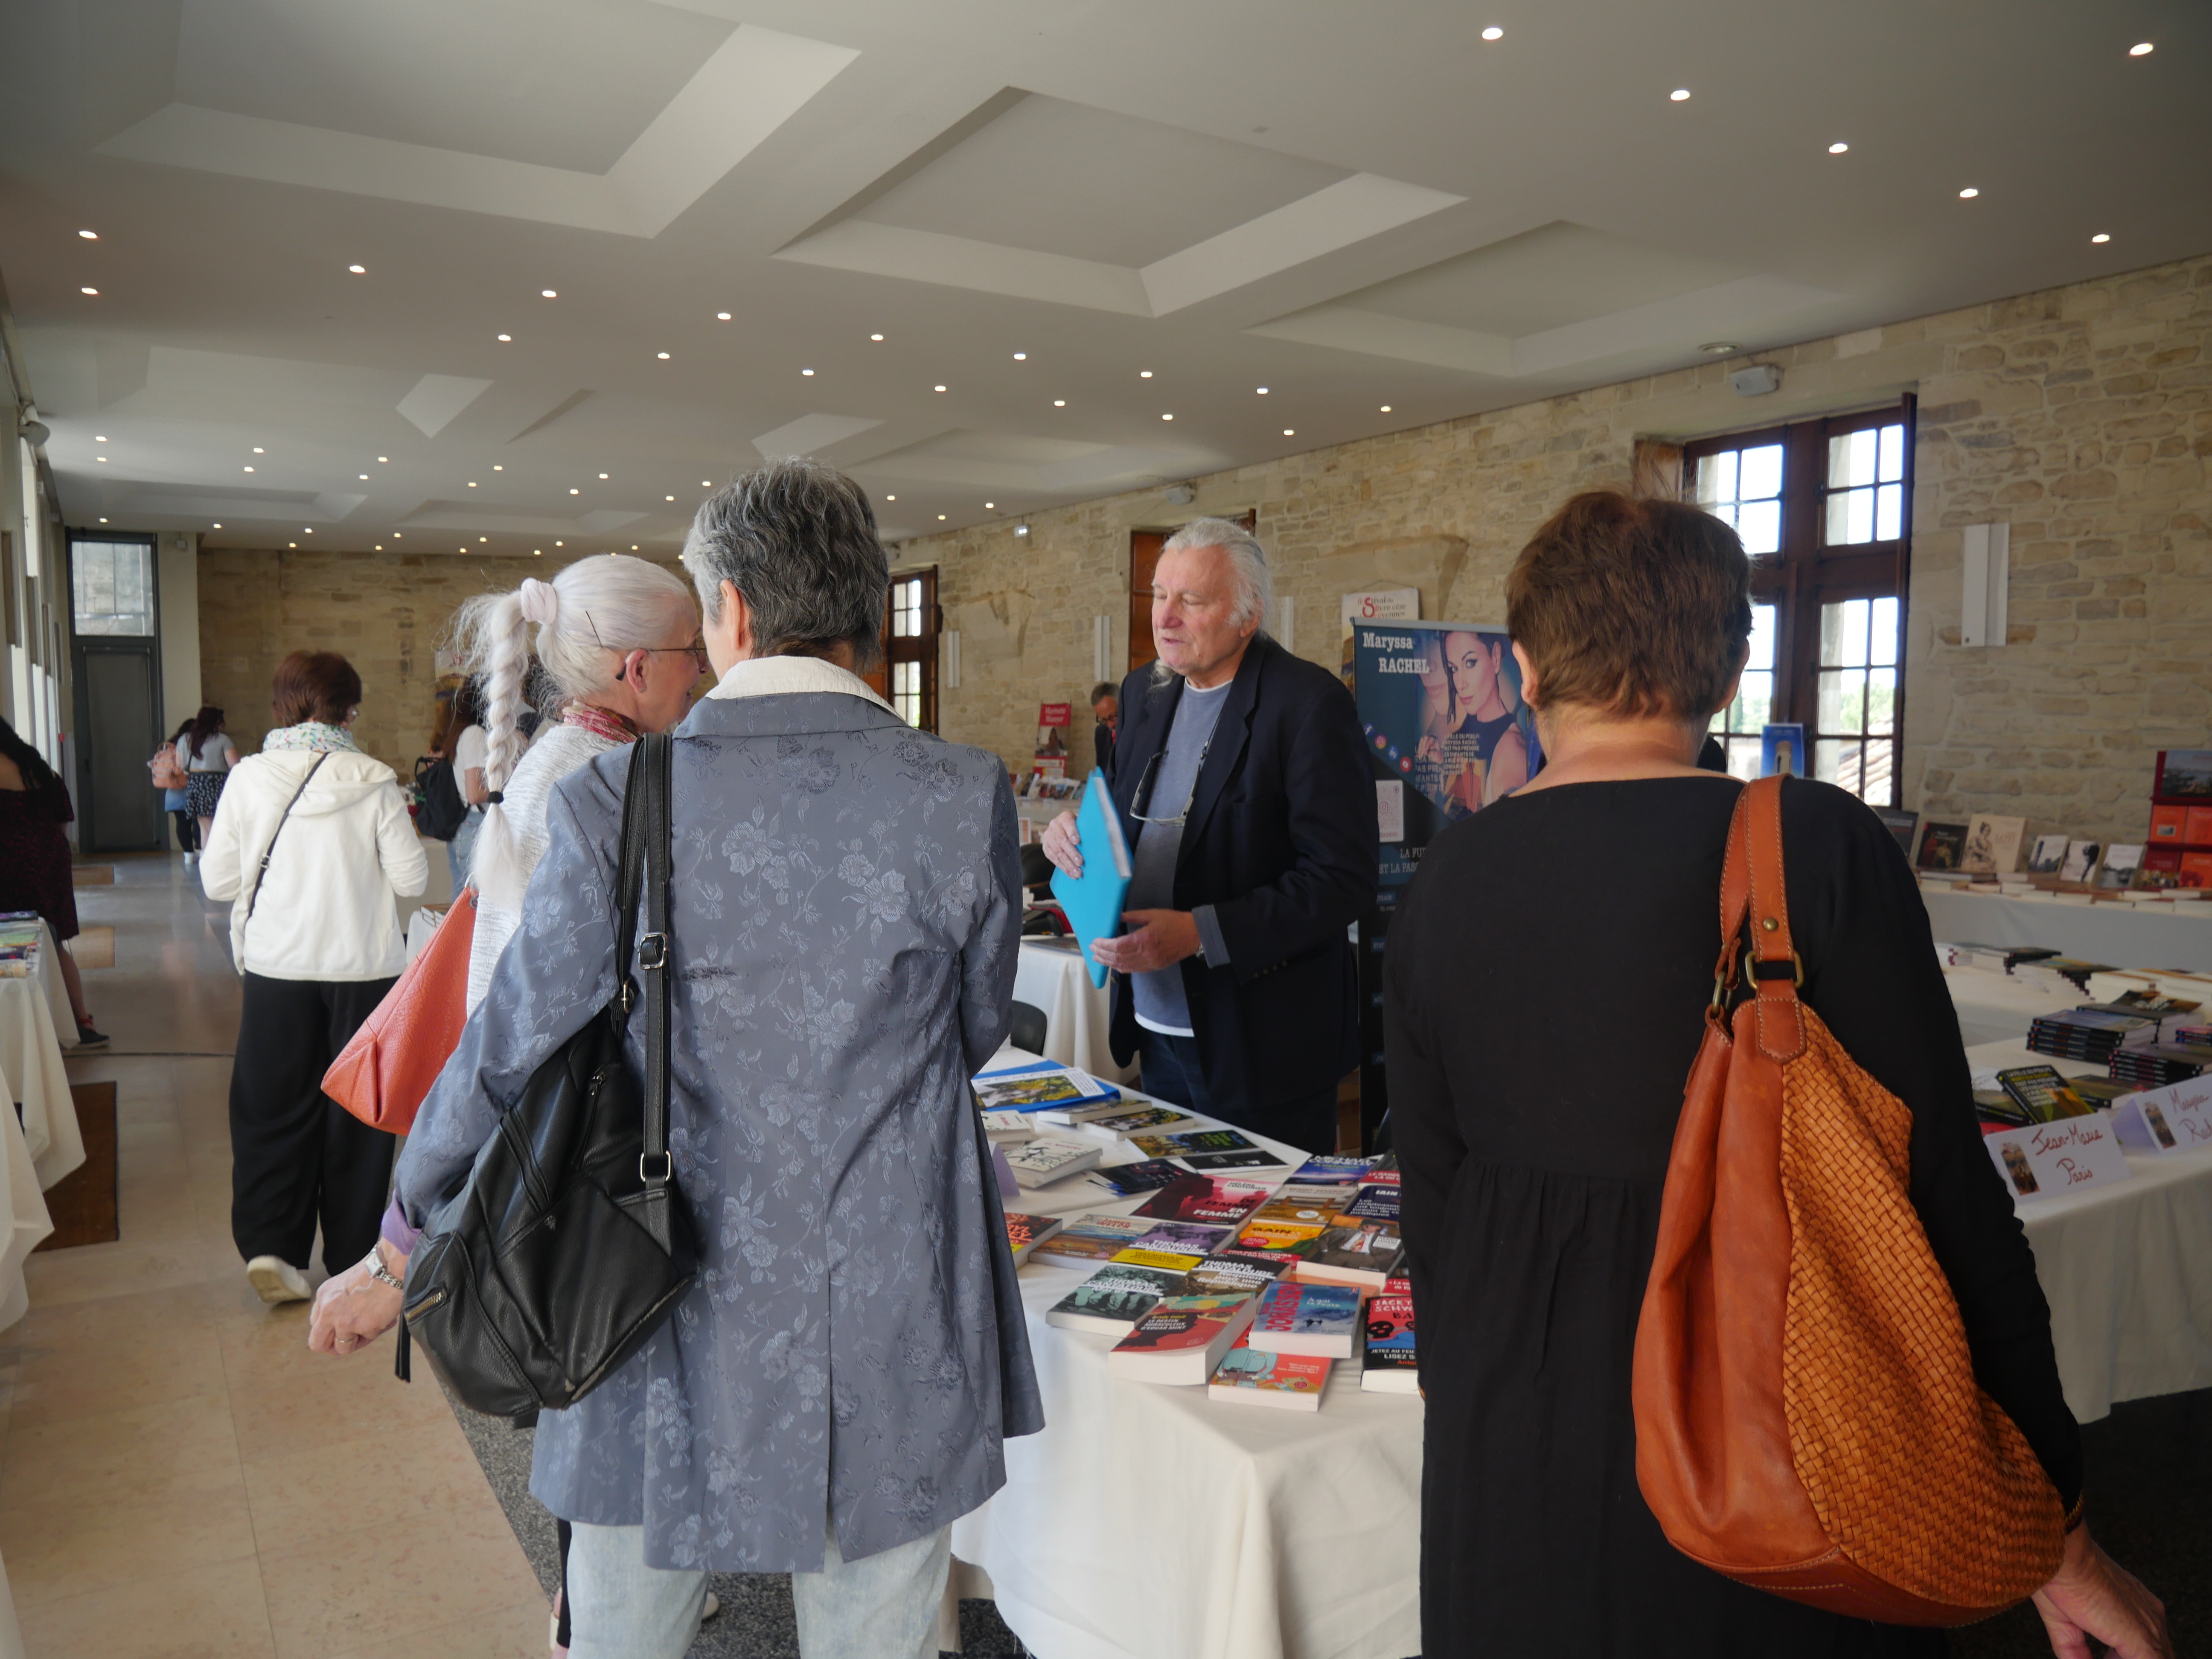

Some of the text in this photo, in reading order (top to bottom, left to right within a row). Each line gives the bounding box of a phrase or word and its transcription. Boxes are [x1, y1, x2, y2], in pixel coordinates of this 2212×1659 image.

[1362, 632, 1413, 653] Maryssa
[1378, 657, 1429, 674] RACHEL
[1400, 848, 1410, 859] LA
[1379, 863, 1388, 874] ET
[1390, 863, 1400, 873] LA
[2031, 1122, 2104, 1156] Jean-Marie
[2056, 1157, 2093, 1186] Paris
[1193, 1208, 1243, 1219] FEMME
[1153, 1239, 1200, 1249] THOMAS
[1198, 1264, 1275, 1277] CANTALOUBE
[1204, 1260, 1253, 1270] THOMAS
